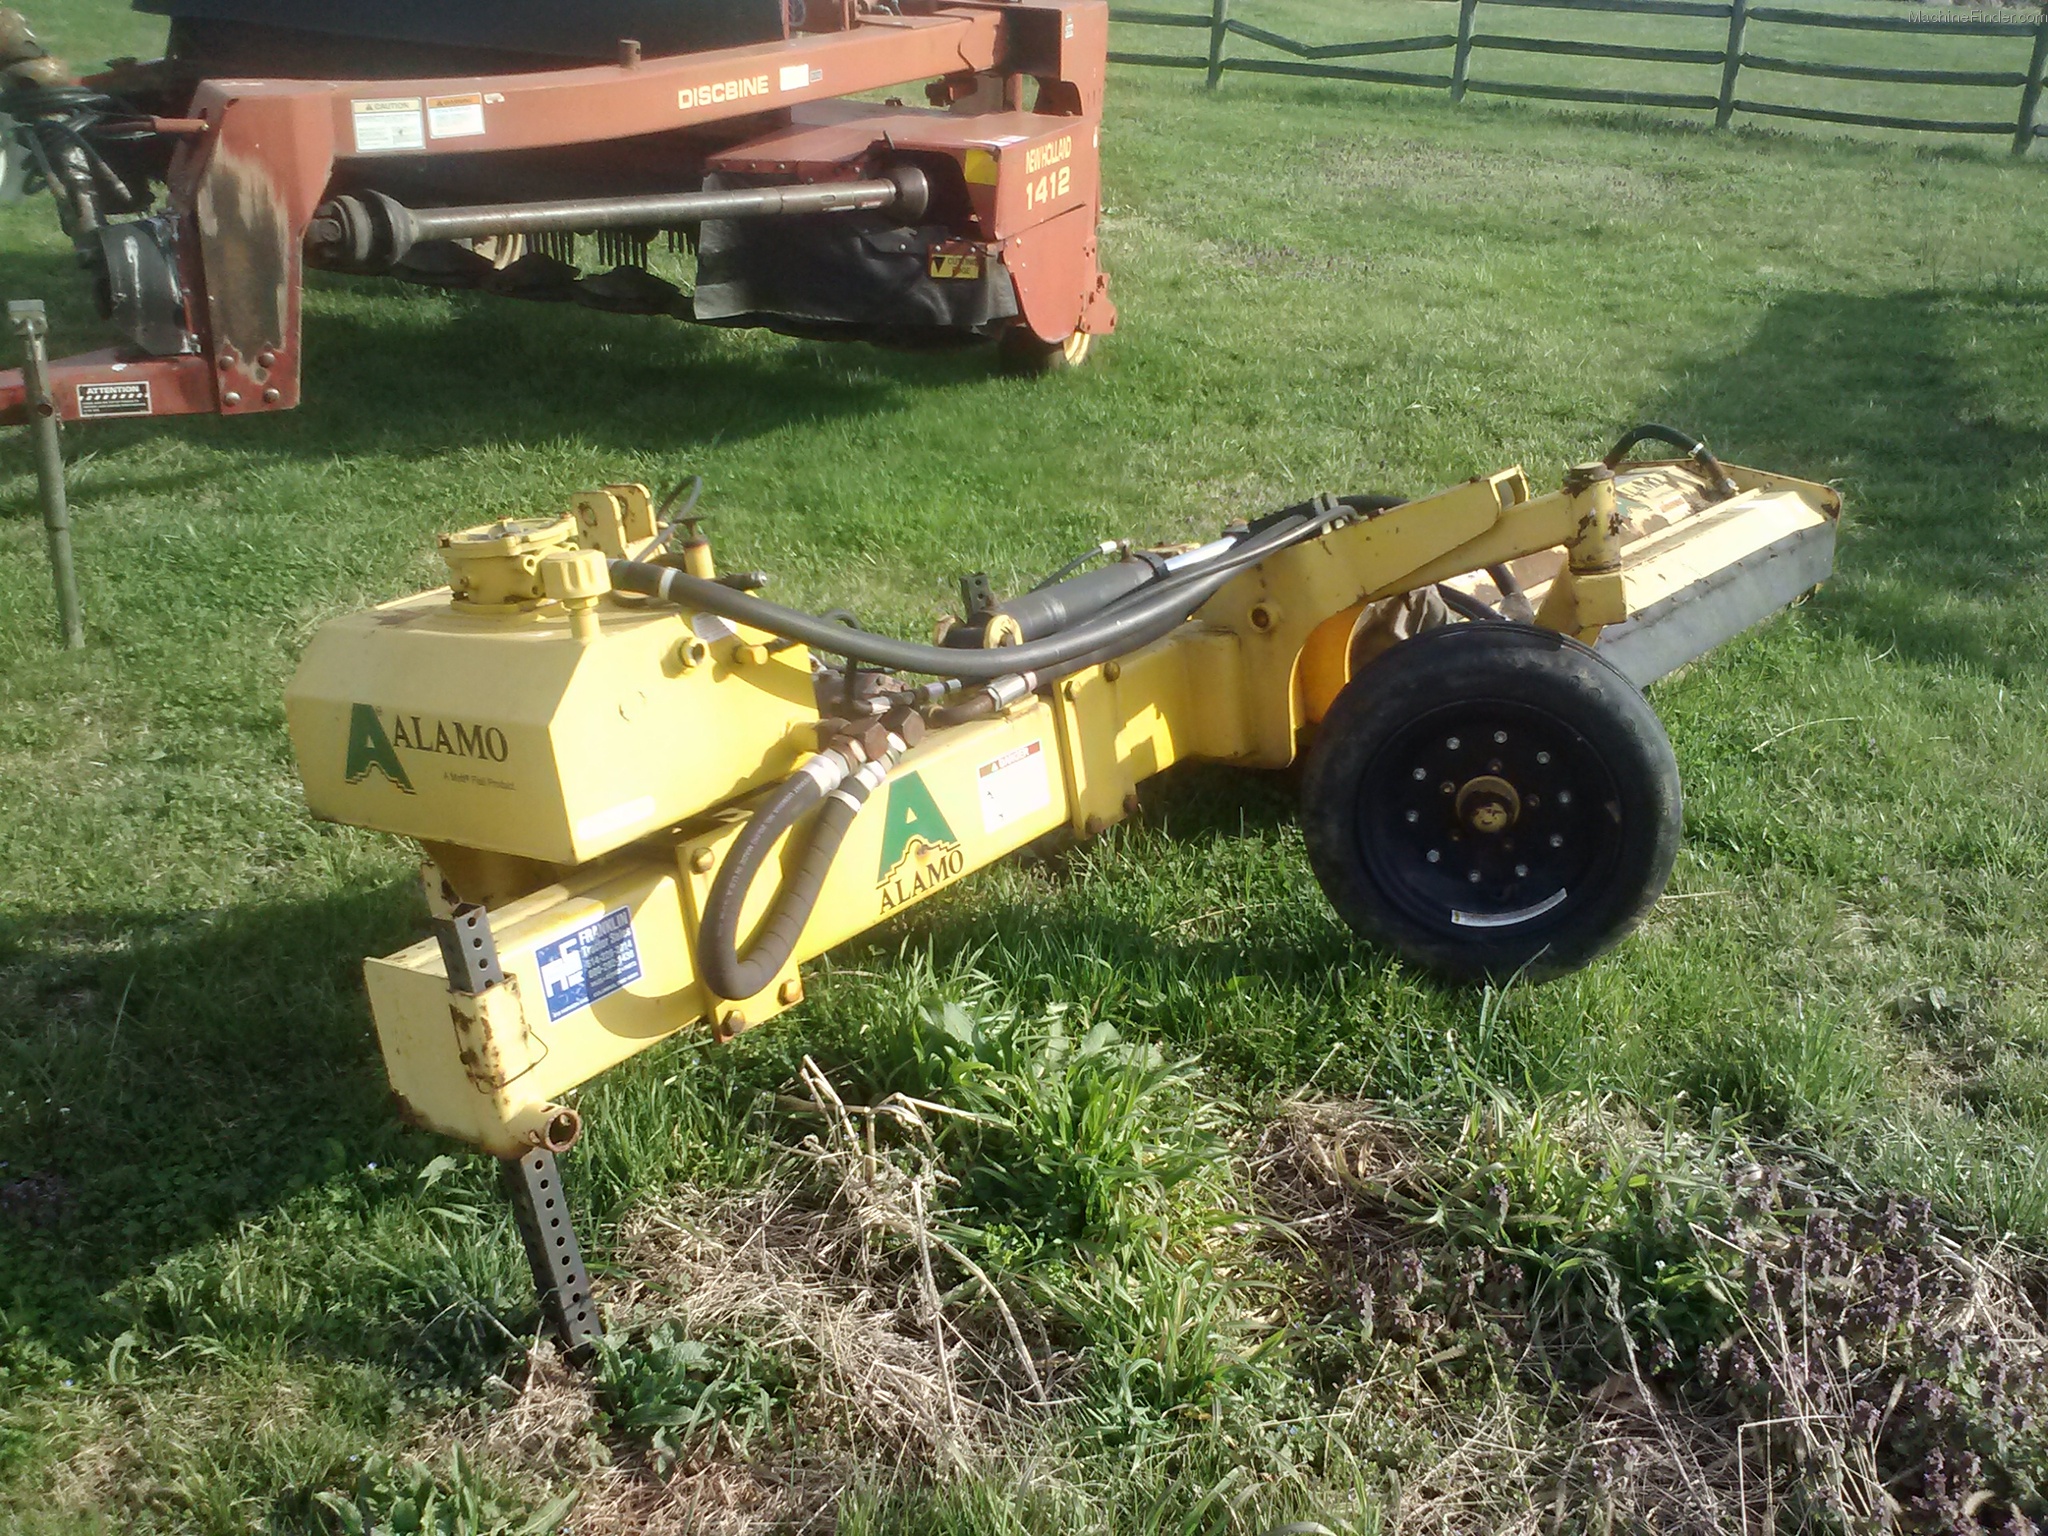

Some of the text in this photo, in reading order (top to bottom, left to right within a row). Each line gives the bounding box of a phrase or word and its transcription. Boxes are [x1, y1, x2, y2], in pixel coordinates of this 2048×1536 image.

[374, 102, 410, 111] CAUTION
[677, 75, 769, 110] DISCBINE
[1025, 135, 1072, 175] NEW HOLLAND
[1025, 165, 1071, 211] 1412
[86, 385, 140, 395] ATTENTION
[393, 714, 509, 763] ALAMO
[879, 849, 964, 915] ALAMO
